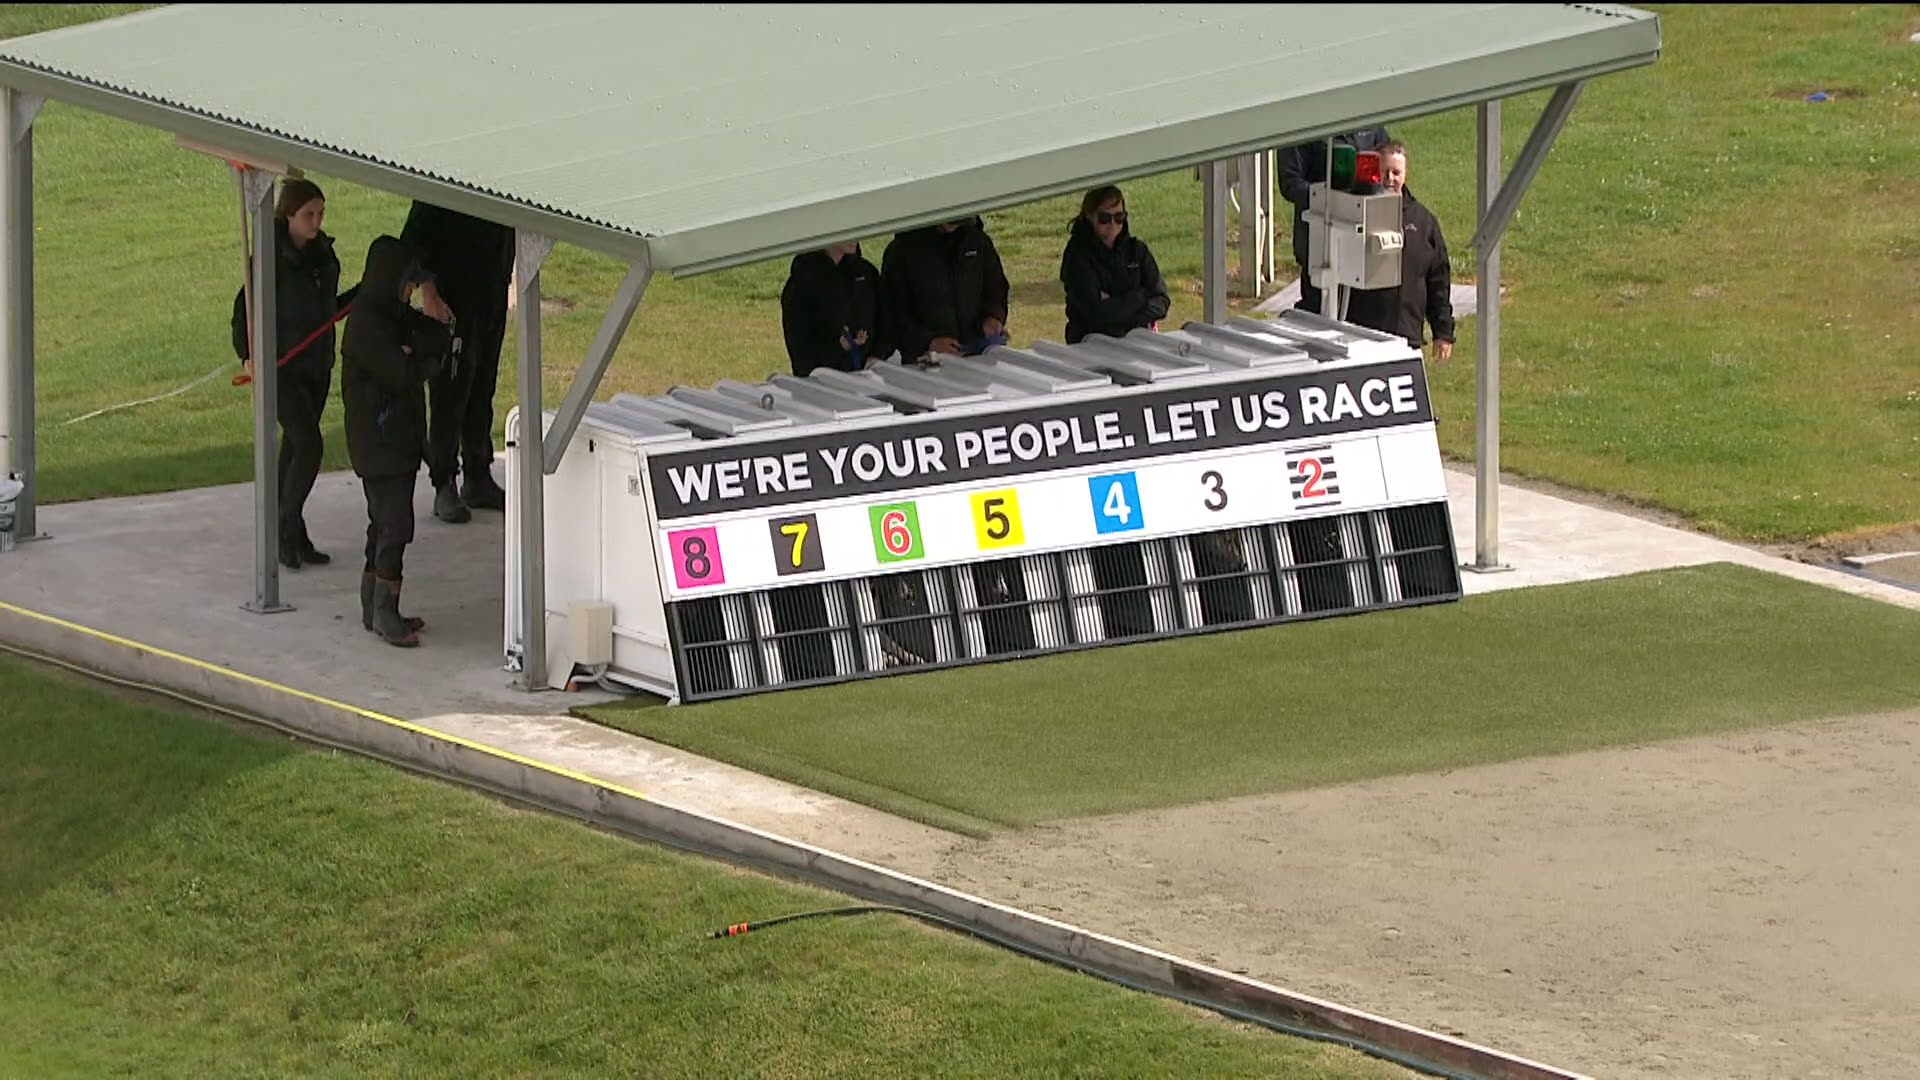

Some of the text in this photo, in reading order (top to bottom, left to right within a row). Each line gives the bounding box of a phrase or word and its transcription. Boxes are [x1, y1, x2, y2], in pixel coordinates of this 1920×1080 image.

[668, 452, 812, 504] WE'RE
[819, 436, 946, 485] YOUR
[954, 411, 1135, 469] PEOPLE.
[1143, 399, 1220, 446] LET
[1232, 391, 1290, 434] US
[1300, 375, 1417, 425] RACE
[683, 457, 1328, 579] 8 7 6 5 4 3 2
